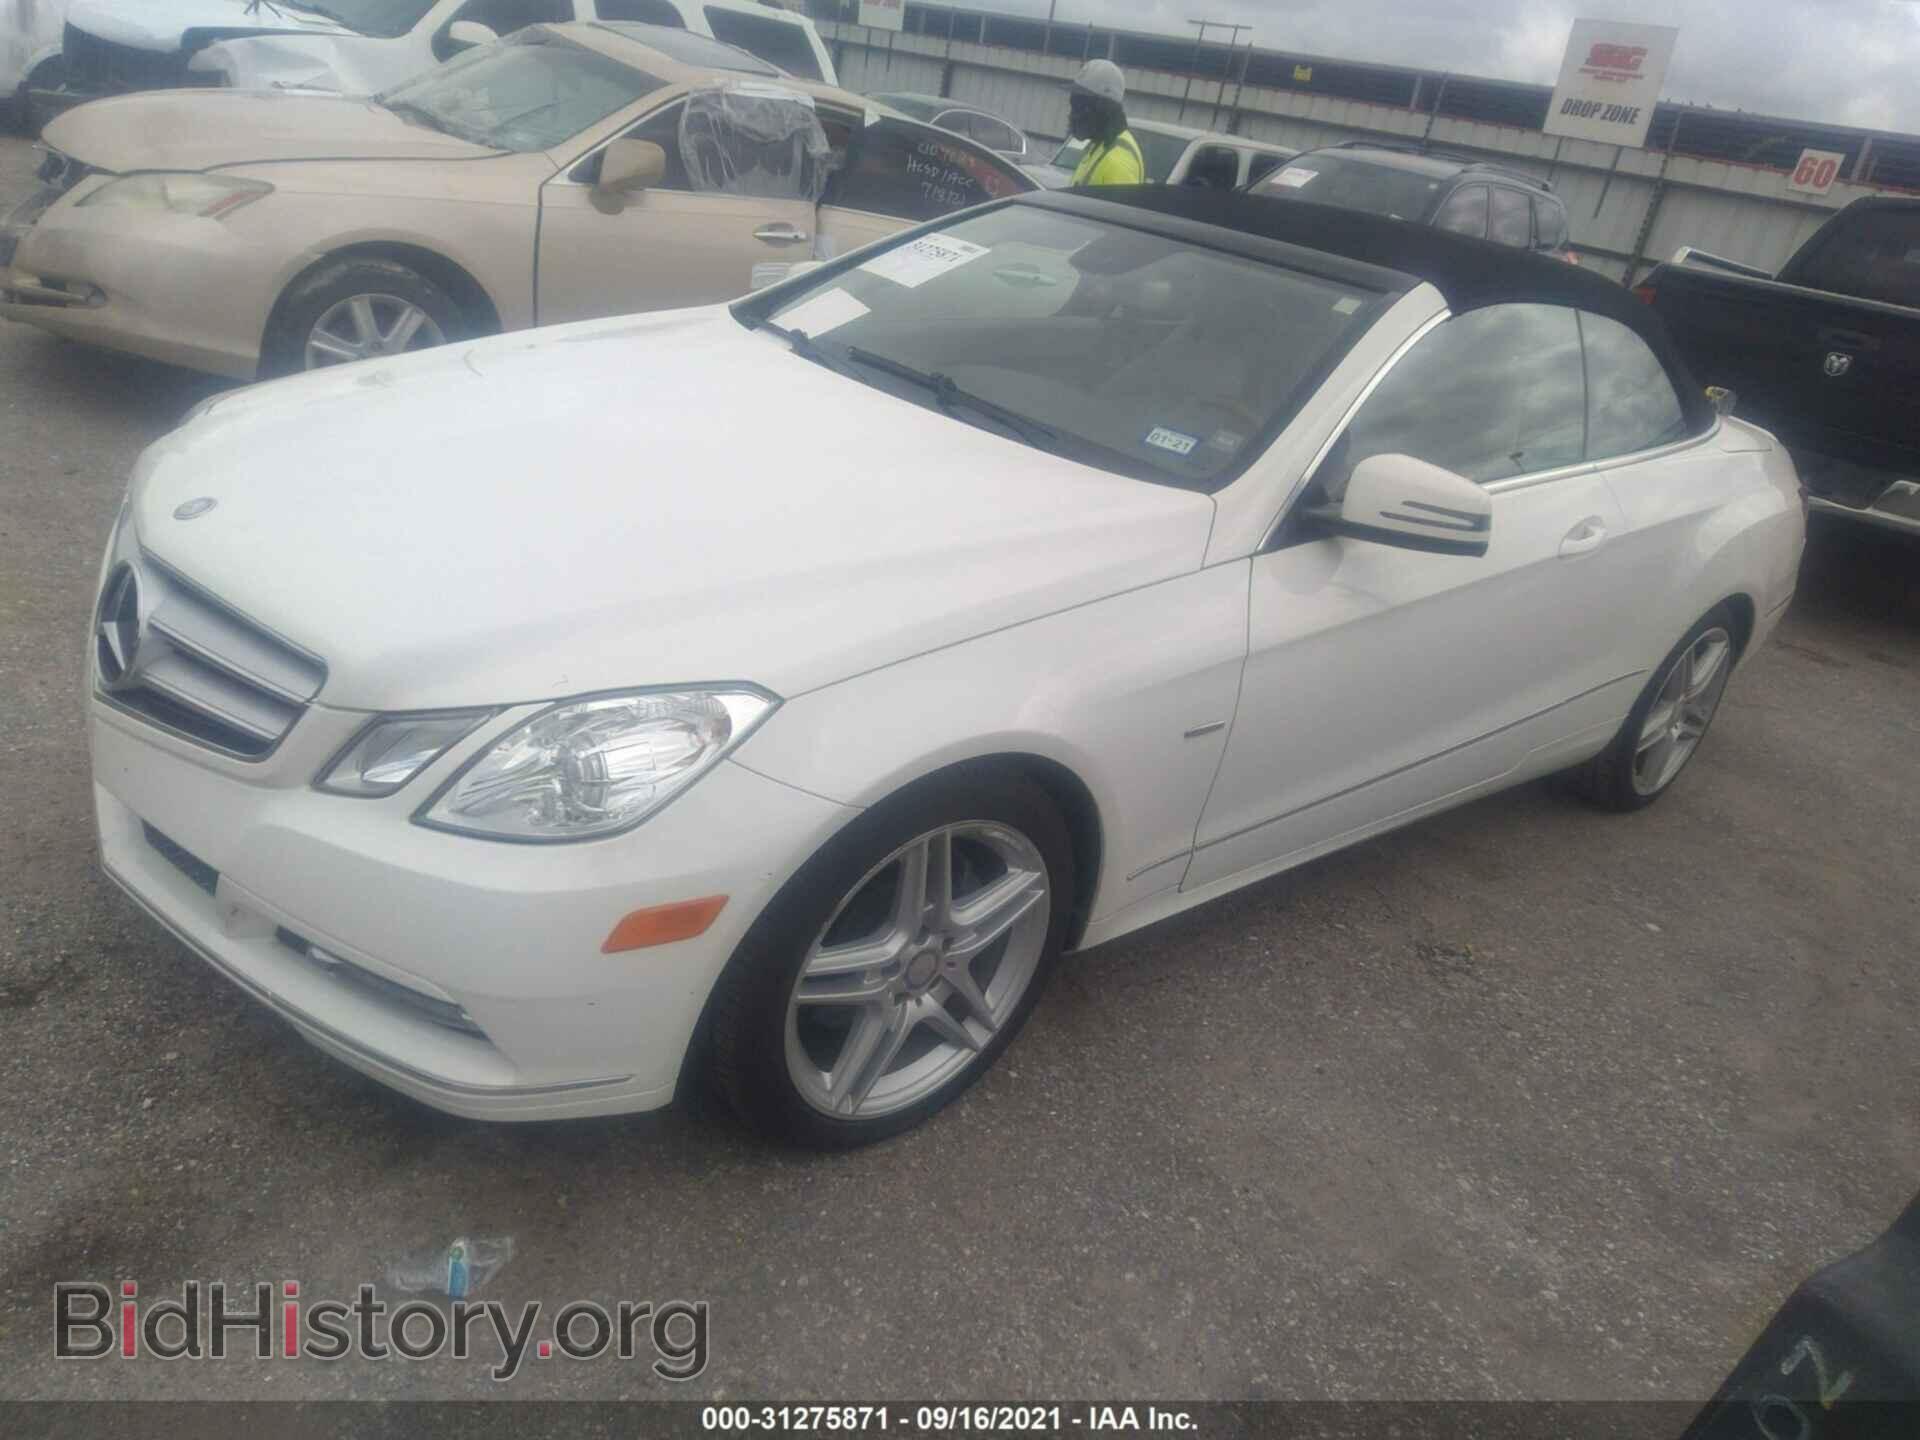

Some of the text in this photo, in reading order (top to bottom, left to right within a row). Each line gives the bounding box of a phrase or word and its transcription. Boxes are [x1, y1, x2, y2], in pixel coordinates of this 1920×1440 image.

[1560, 98, 1641, 125] DROP ZONE
[1793, 157, 1837, 189] 60
